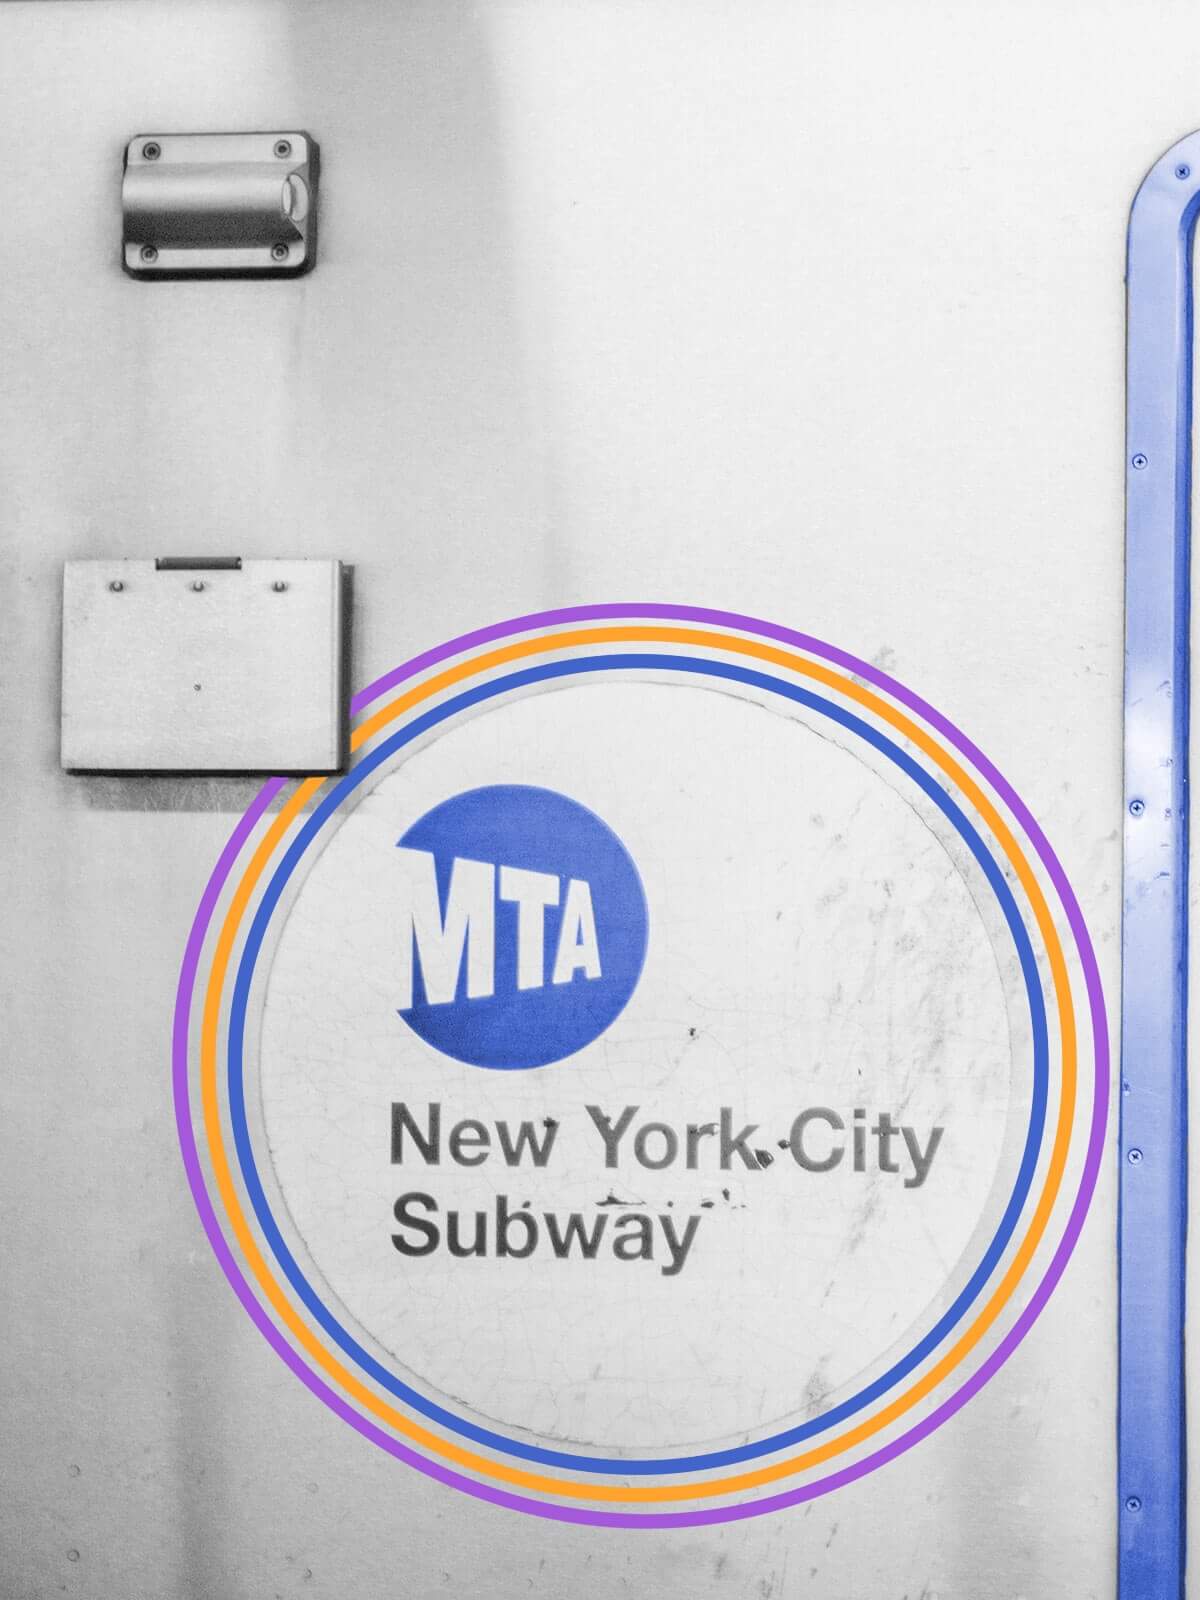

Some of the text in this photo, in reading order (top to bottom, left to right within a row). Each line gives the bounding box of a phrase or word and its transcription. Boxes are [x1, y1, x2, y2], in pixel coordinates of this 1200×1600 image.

[396, 846, 602, 1010] MTA
[390, 1101, 945, 1190] New York City
[390, 1191, 701, 1277] Subway
